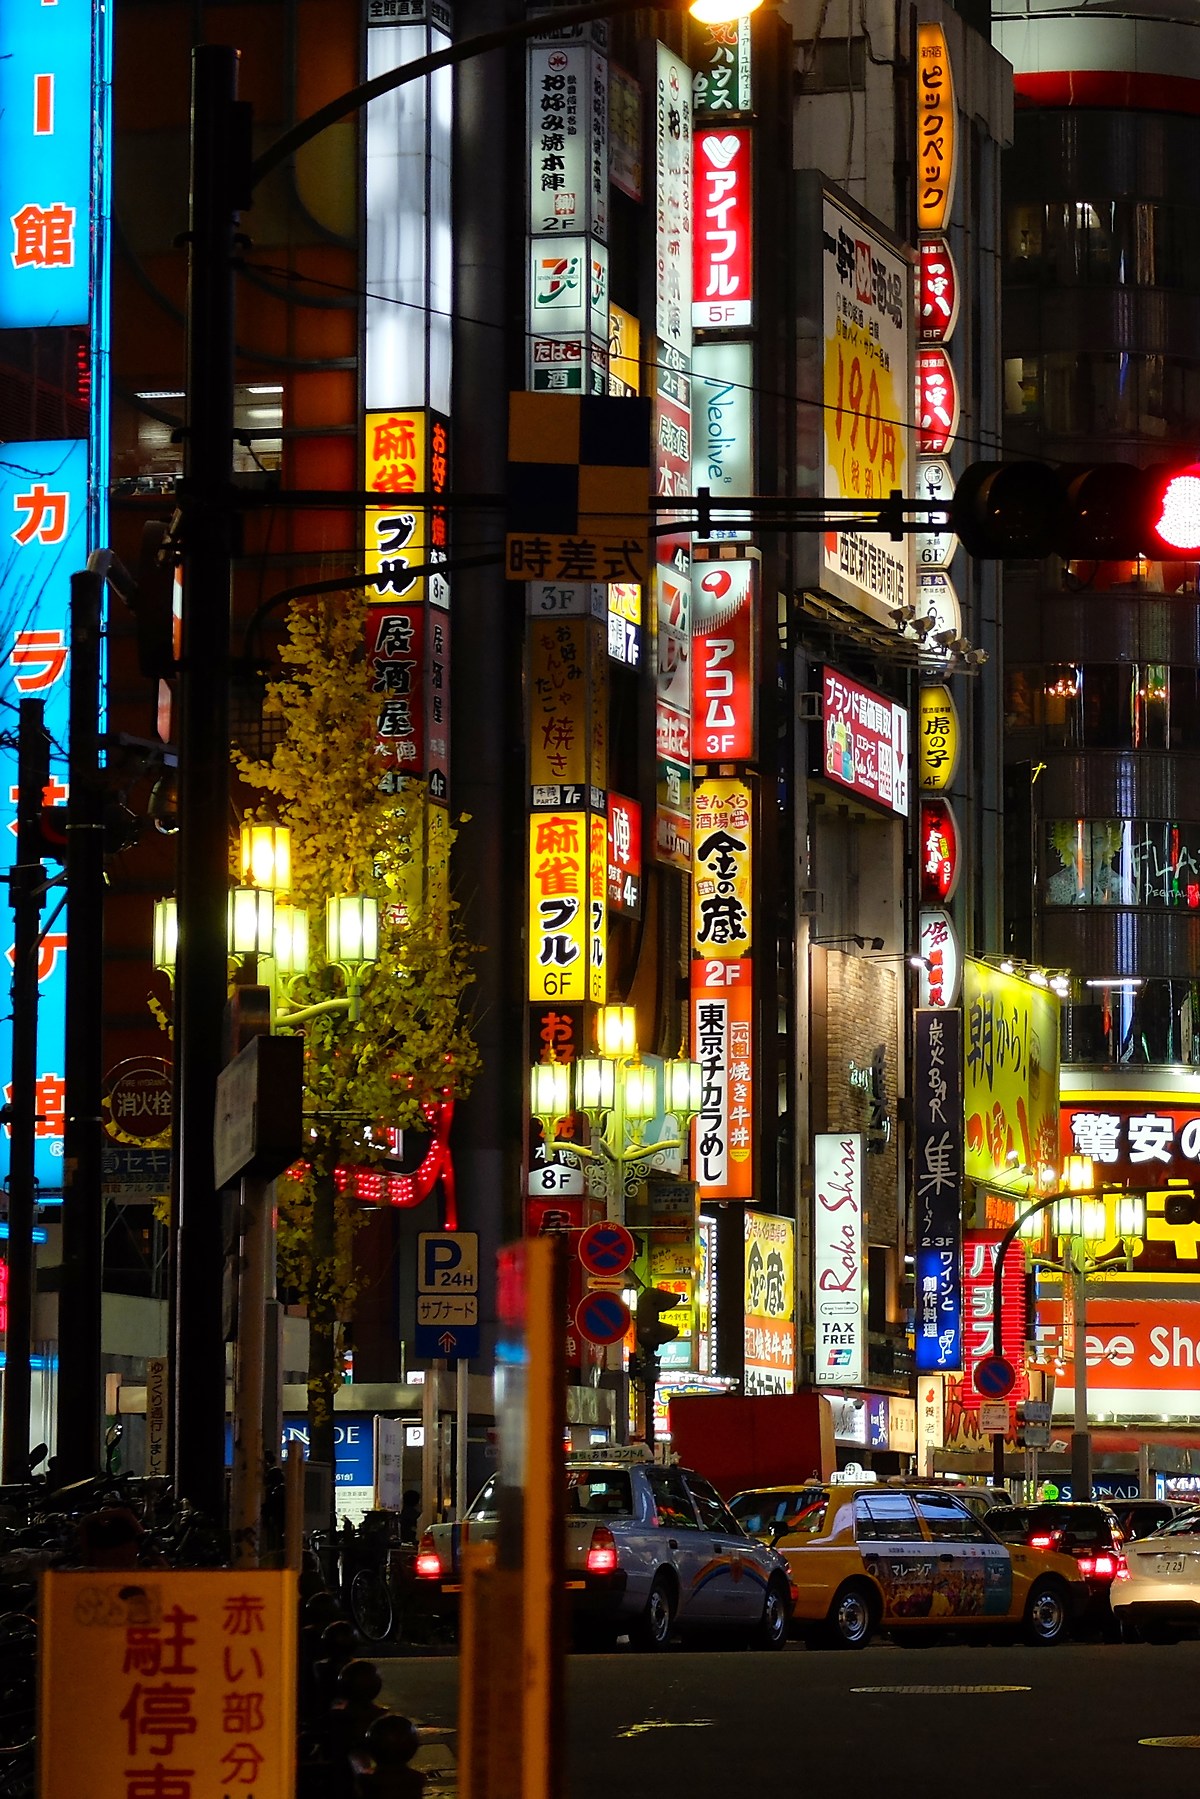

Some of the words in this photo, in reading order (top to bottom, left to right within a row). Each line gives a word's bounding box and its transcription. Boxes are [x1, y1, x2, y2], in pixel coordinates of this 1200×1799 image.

[541, 75, 566, 191] お好み焼本陣
[922, 65, 944, 209] ピックペック
[542, 218, 575, 230] 2F
[706, 170, 740, 296] アイフル
[823, 226, 903, 329] 一軒め酒場
[709, 306, 735, 322] 5F
[535, 343, 581, 361] たばこ
[547, 370, 569, 388] 酒
[659, 414, 689, 462] 居酒屋
[704, 380, 736, 479] Neolive
[923, 439, 943, 449] 7F
[372, 418, 417, 595] 麻雀ブル
[509, 538, 644, 581] 時差式
[675, 549, 689, 572] 4F
[840, 536, 904, 607] 西武新宿駅前店
[921, 548, 944, 563] 6F
[432, 577, 445, 601] 8F
[540, 586, 575, 611] 3F
[555, 625, 583, 680] お好み
[625, 624, 639, 665] 7F
[372, 615, 417, 738] 居酒屋
[540, 634, 570, 706] もんじゃ
[705, 638, 735, 728] アコム
[535, 676, 558, 714] たこ
[826, 677, 892, 739] ブランド高価買取
[541, 716, 576, 778] 焼き
[705, 735, 735, 753] 3F
[925, 716, 950, 769] 虎の子
[430, 775, 445, 796] 4F
[536, 797, 559, 805] PART2
[563, 785, 582, 804] 7F
[695, 793, 748, 810] きんくら
[923, 775, 940, 786] 4F
[696, 812, 729, 829] 酒場
[534, 816, 581, 968] 麻雀ブル
[590, 818, 604, 970] 麻雀ブル
[622, 875, 637, 907] 4F
[696, 830, 748, 944] 金の蔵
[943, 862, 951, 884] 3F
[543, 972, 573, 995] 6F
[705, 960, 741, 987] 2F
[928, 1018, 947, 1124] 炭火BAR
[117, 1090, 172, 1118] 消火栓
[698, 1003, 725, 1182] 東京チカラめし
[729, 1061, 751, 1147] 焼き牛丼
[541, 1170, 571, 1190] 8F
[818, 1138, 858, 1213] Shira
[917, 1131, 957, 1196] 集
[424, 1238, 462, 1287] P
[440, 1272, 474, 1287] 24H
[747, 1240, 786, 1315] 金の蔵
[819, 1224, 858, 1294] Roko
[940, 1252, 954, 1311] ワインと
[421, 1300, 474, 1320] サブナード
[822, 1322, 855, 1333] TAX
[922, 1276, 938, 1338] 創作料理
[822, 1334, 856, 1345] FREE
[818, 1371, 859, 1380] ロコシーラ
